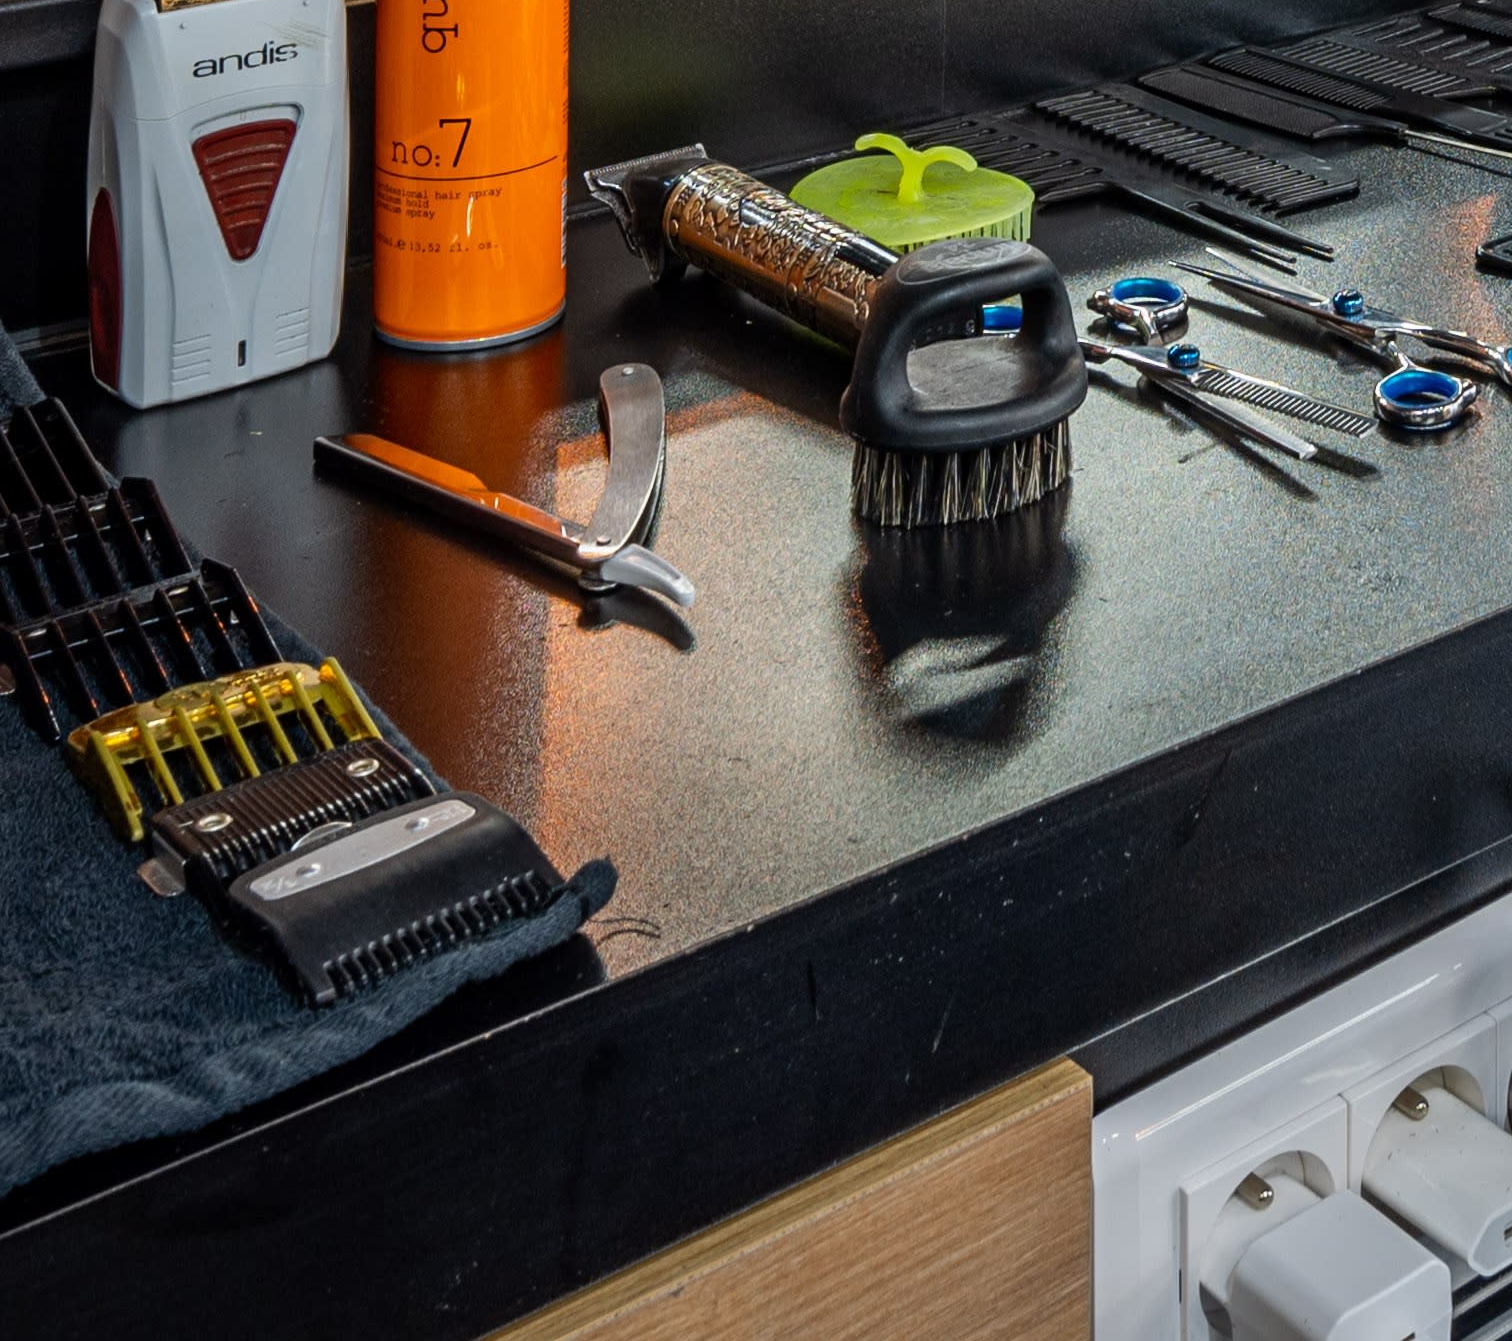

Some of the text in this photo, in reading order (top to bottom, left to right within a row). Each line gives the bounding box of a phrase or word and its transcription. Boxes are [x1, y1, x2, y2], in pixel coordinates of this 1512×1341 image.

[191, 38, 300, 81] andis
[435, 189, 462, 200] hair
[406, 198, 429, 209] hold
[406, 207, 436, 221] spray
